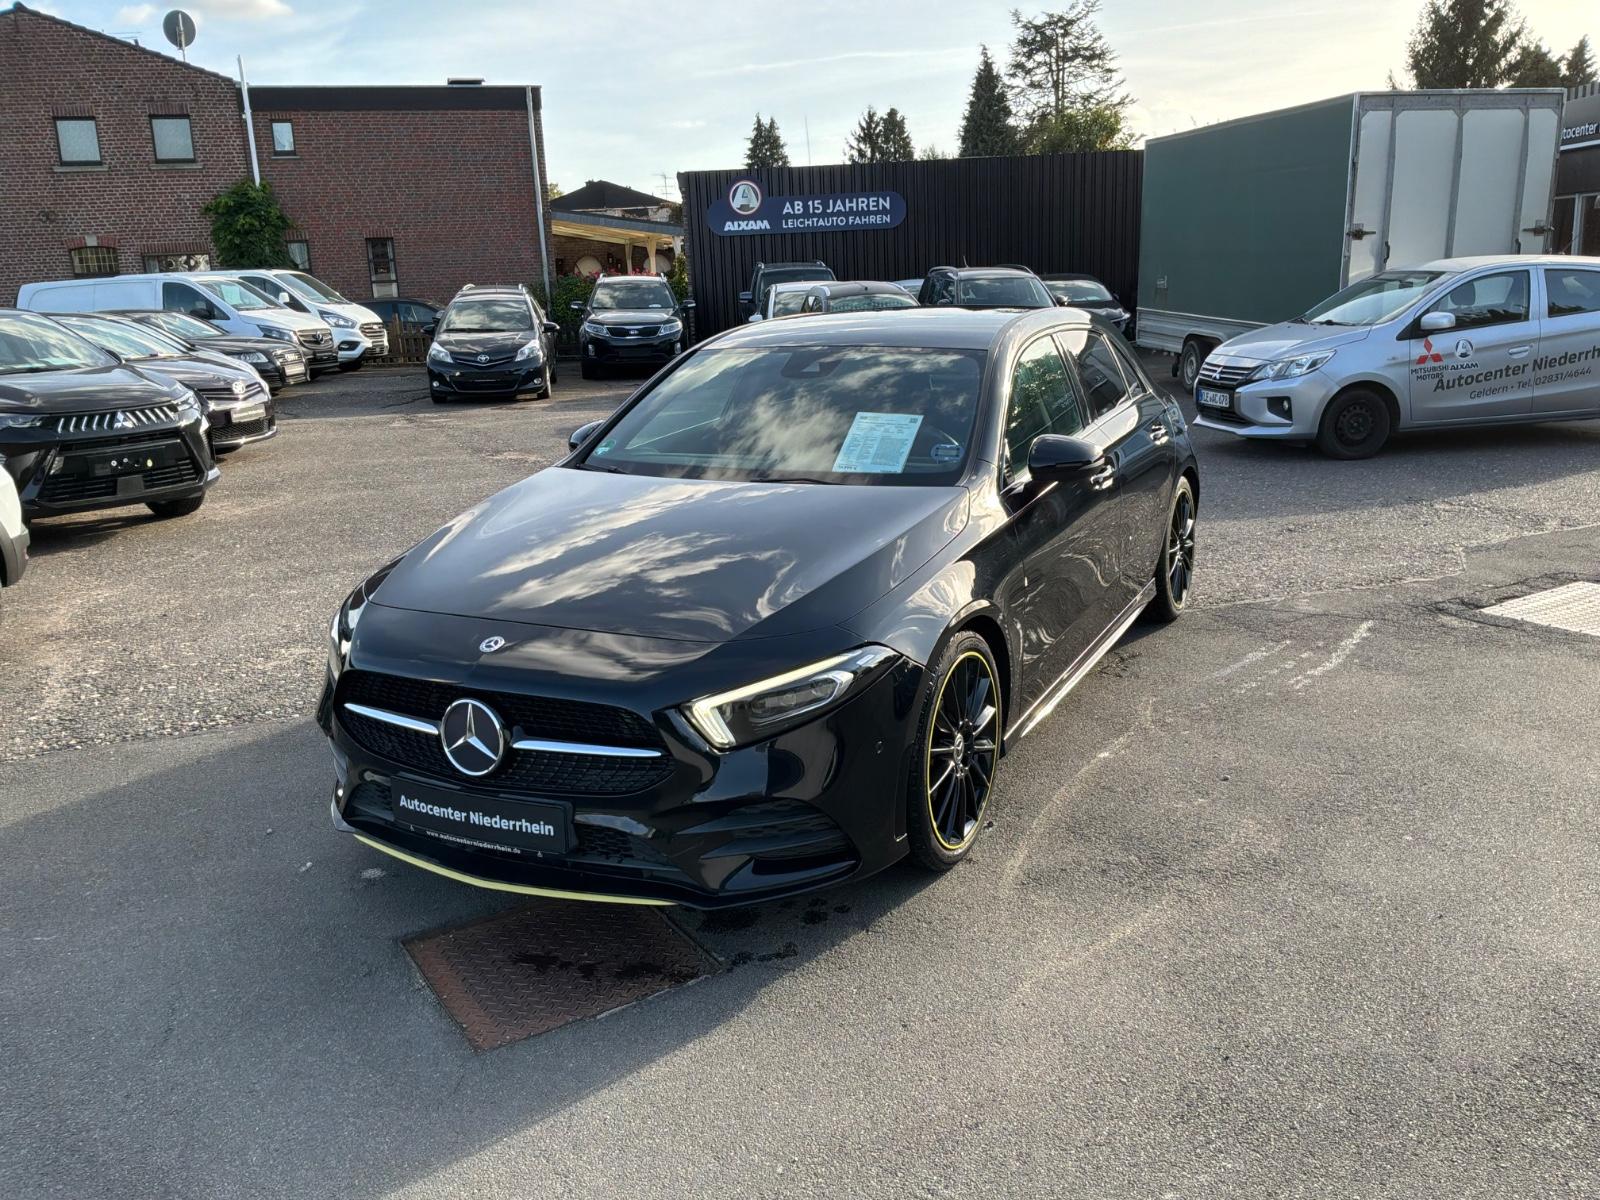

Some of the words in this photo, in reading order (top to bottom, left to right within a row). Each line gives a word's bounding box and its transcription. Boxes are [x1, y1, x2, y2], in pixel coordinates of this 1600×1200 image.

[1561, 122, 1598, 140] tocenter
[782, 201, 804, 215] AB
[808, 199, 823, 214] 15
[826, 196, 891, 213] JAHREN
[724, 219, 771, 231] AIXAM
[782, 216, 847, 229] LEICHTAUTO
[849, 214, 891, 226] FAHREN
[1410, 364, 1450, 375] MITSUBISHI
[1450, 362, 1479, 371] AIXAM
[1416, 371, 1444, 381] MOTORS
[1433, 363, 1529, 393] Autocenter
[1469, 384, 1509, 400] Geldern
[1535, 367, 1592, 386] 02831/4644
[399, 794, 467, 822] Autocenter
[469, 811, 554, 837] Niederrhein
